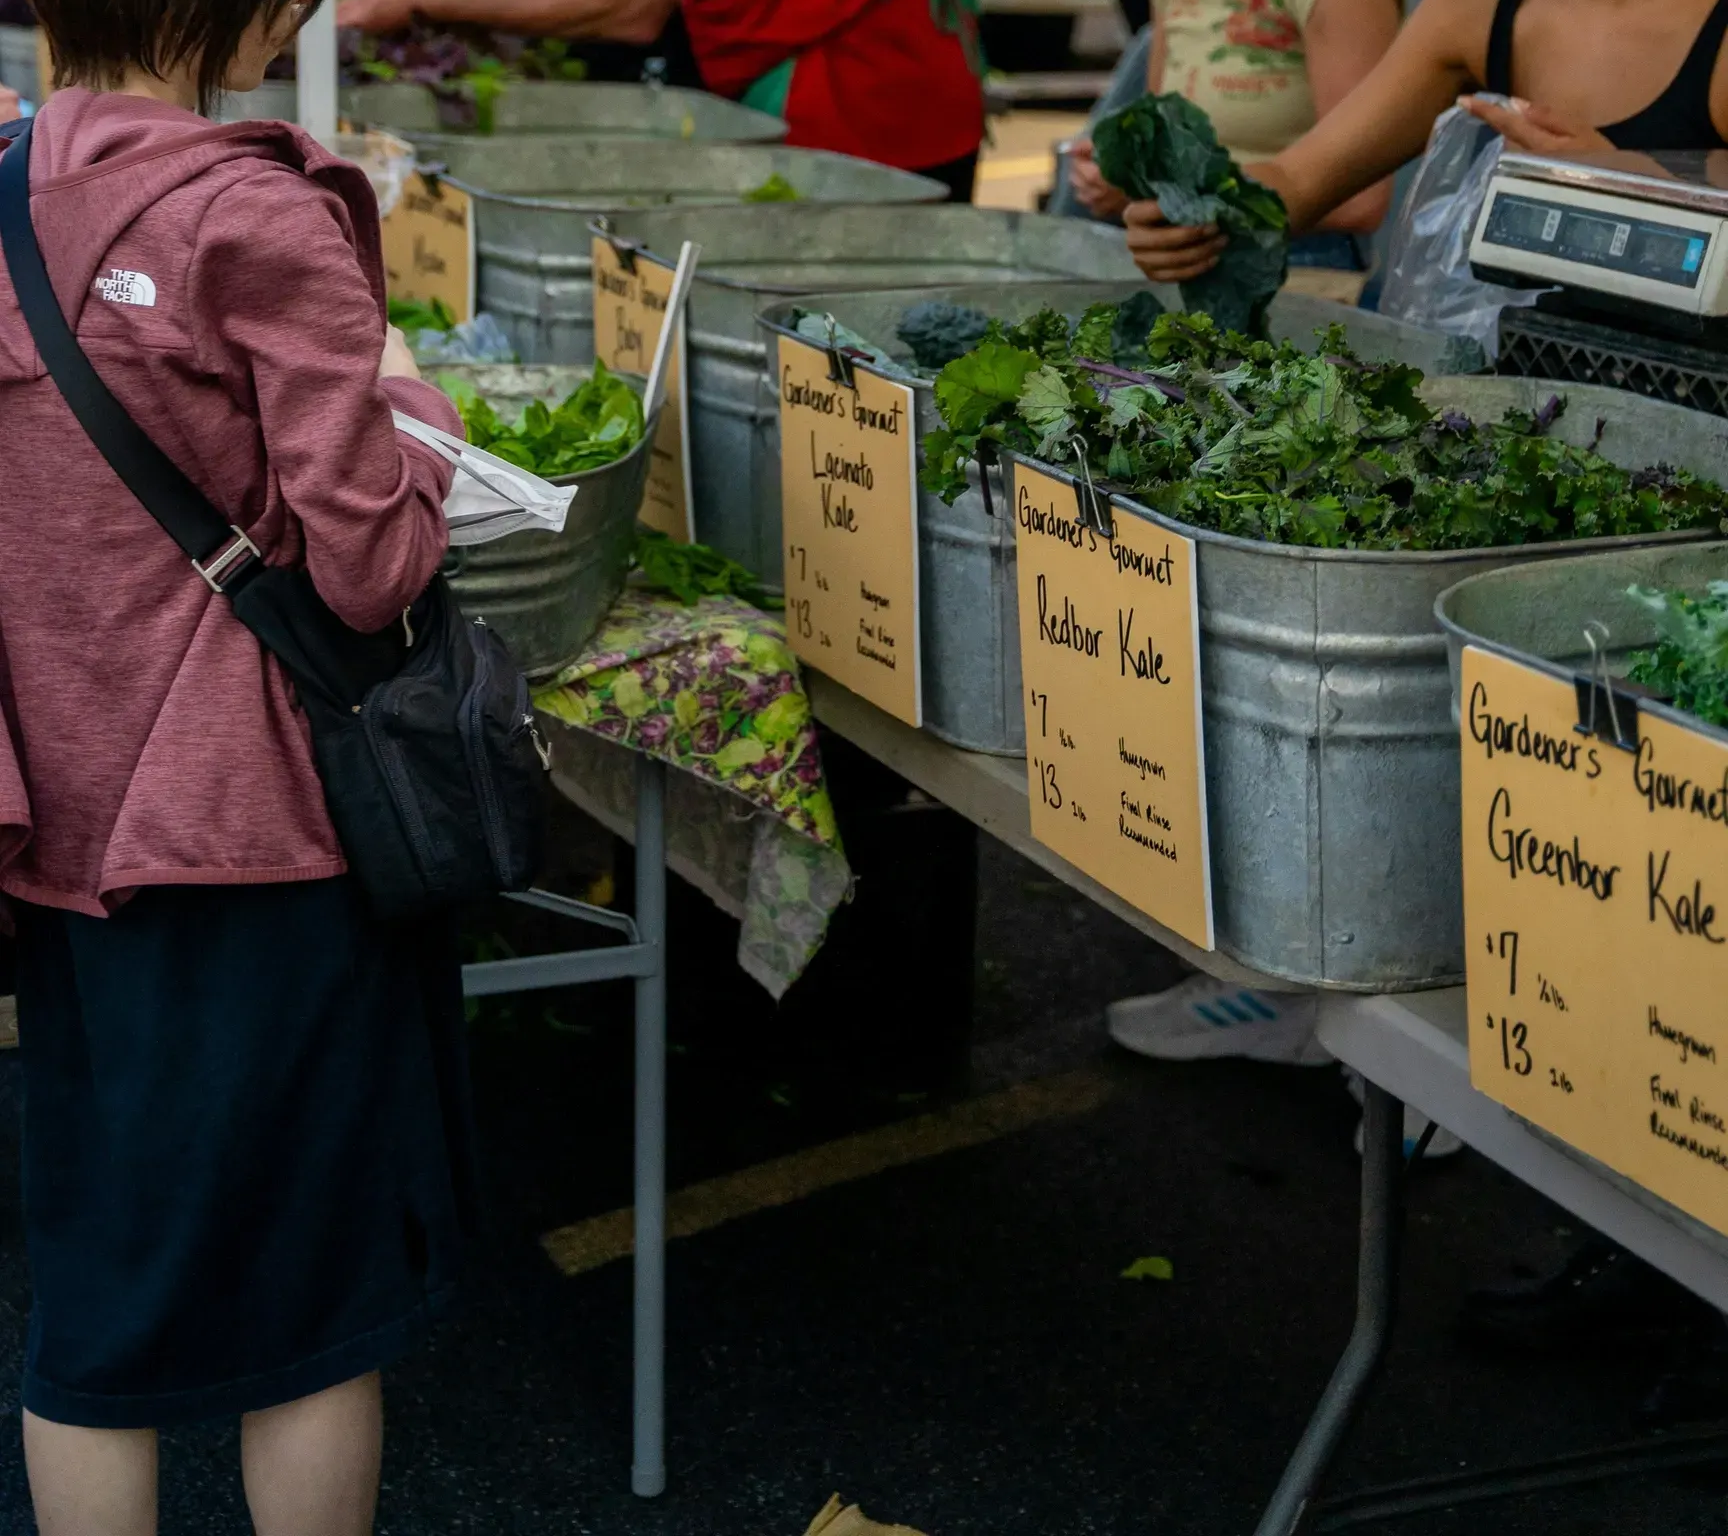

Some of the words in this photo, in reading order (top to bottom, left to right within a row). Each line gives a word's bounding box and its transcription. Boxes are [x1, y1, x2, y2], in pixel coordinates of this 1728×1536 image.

[95, 277, 132, 293] NORTH
[103, 290, 132, 304] FACE
[111, 269, 136, 282] THE
[852, 389, 904, 435] Gourmet
[811, 430, 874, 490] Lacinato
[822, 483, 858, 533] Kale
[1018, 484, 1098, 552] Gardeners
[1109, 518, 1174, 586] Gourmet
[1036, 573, 1104, 658] Redbor
[1118, 607, 1171, 684] Kale
[1468, 681, 1602, 780] Gardeners
[1118, 736, 1166, 781] Homegrown
[1120, 790, 1142, 819] Final
[1146, 804, 1172, 832] Rinse
[1118, 813, 1178, 864] Recommended
[1487, 787, 1621, 901] Greenbor
[1648, 850, 1727, 945] Kale
[1650, 1074, 1682, 1110] Final
[1689, 1095, 1727, 1134] Rinse
[1650, 1110, 1728, 1172] Recommende
